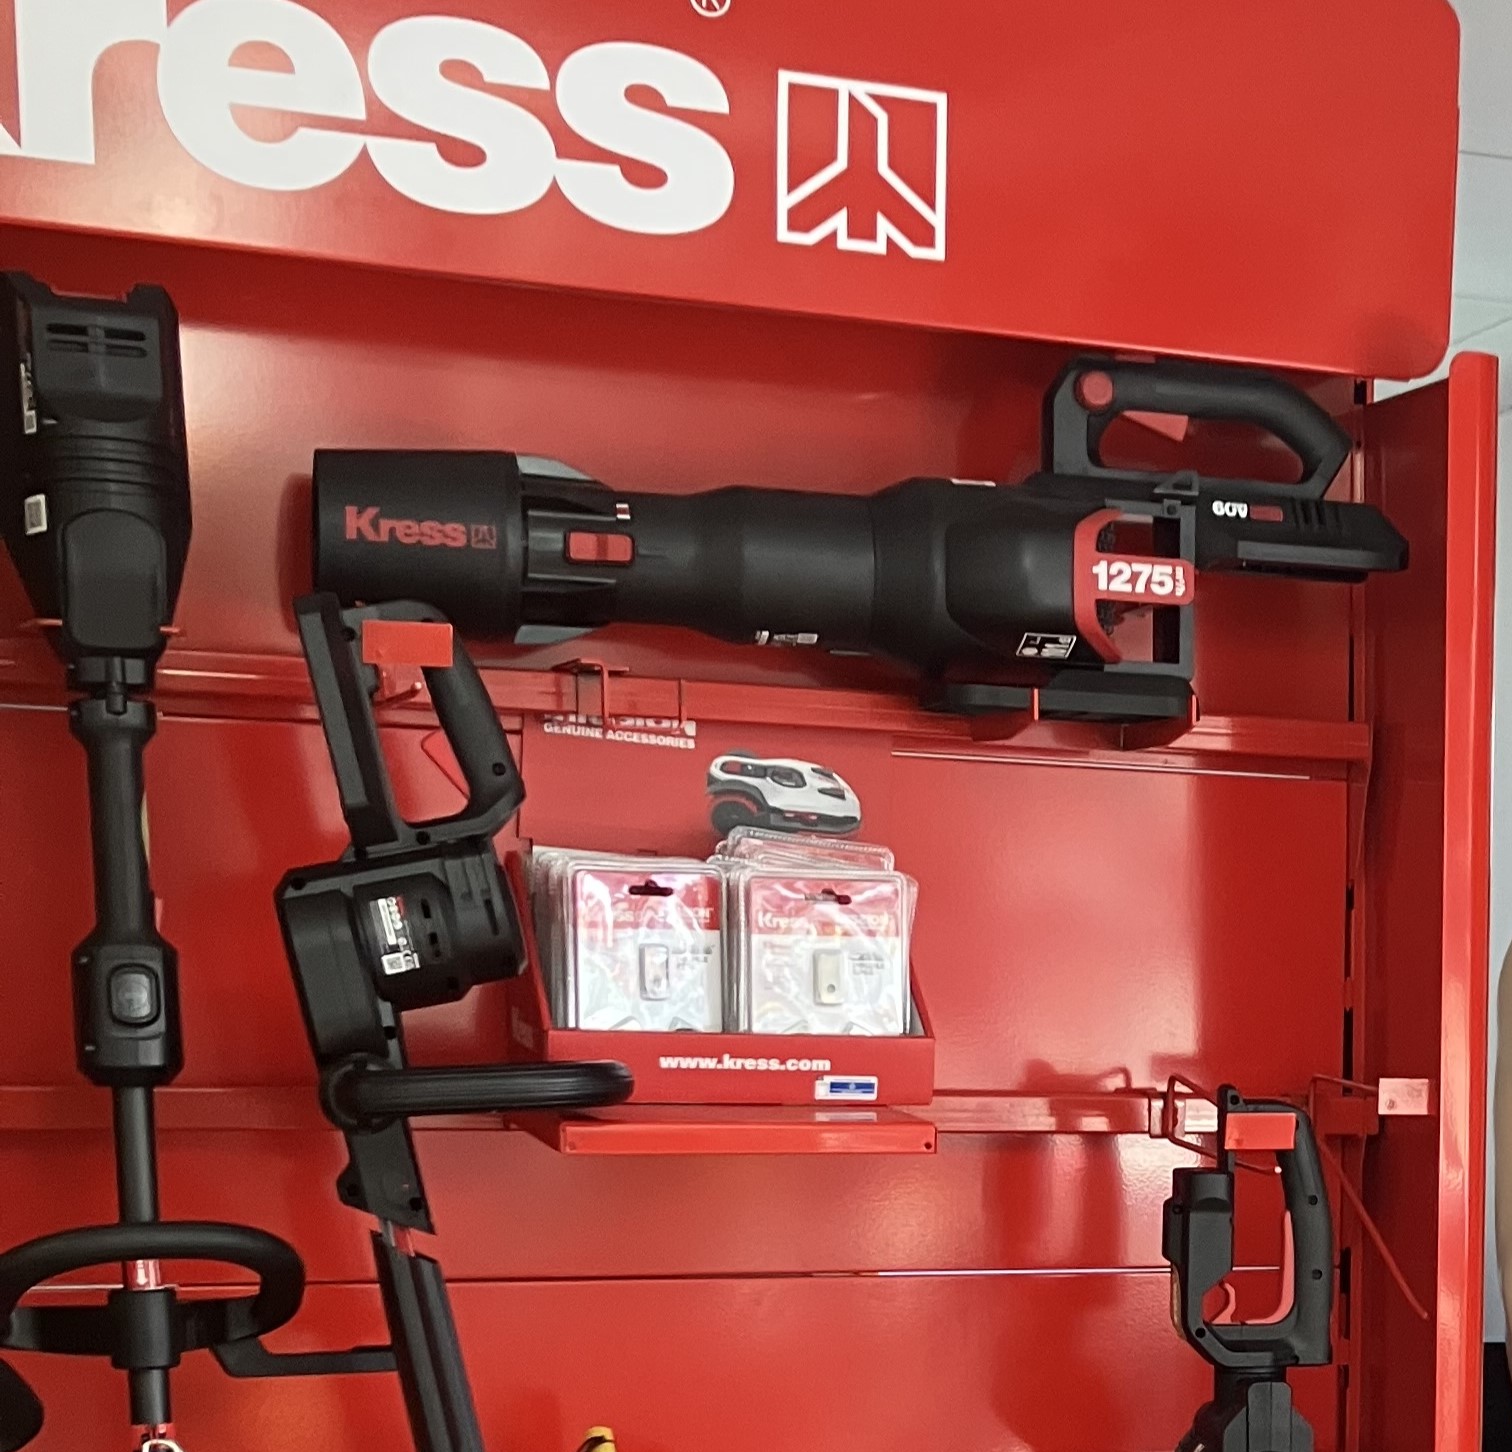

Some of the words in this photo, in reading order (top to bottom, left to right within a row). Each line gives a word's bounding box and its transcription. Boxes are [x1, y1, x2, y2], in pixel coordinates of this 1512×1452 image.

[0, 0, 734, 234] ress
[345, 505, 467, 548] Kress
[1092, 560, 1174, 595] 1275
[543, 722, 603, 739] GENUINE
[606, 729, 695, 749] ACCESSORIES
[660, 1053, 831, 1072] www.kress.com
